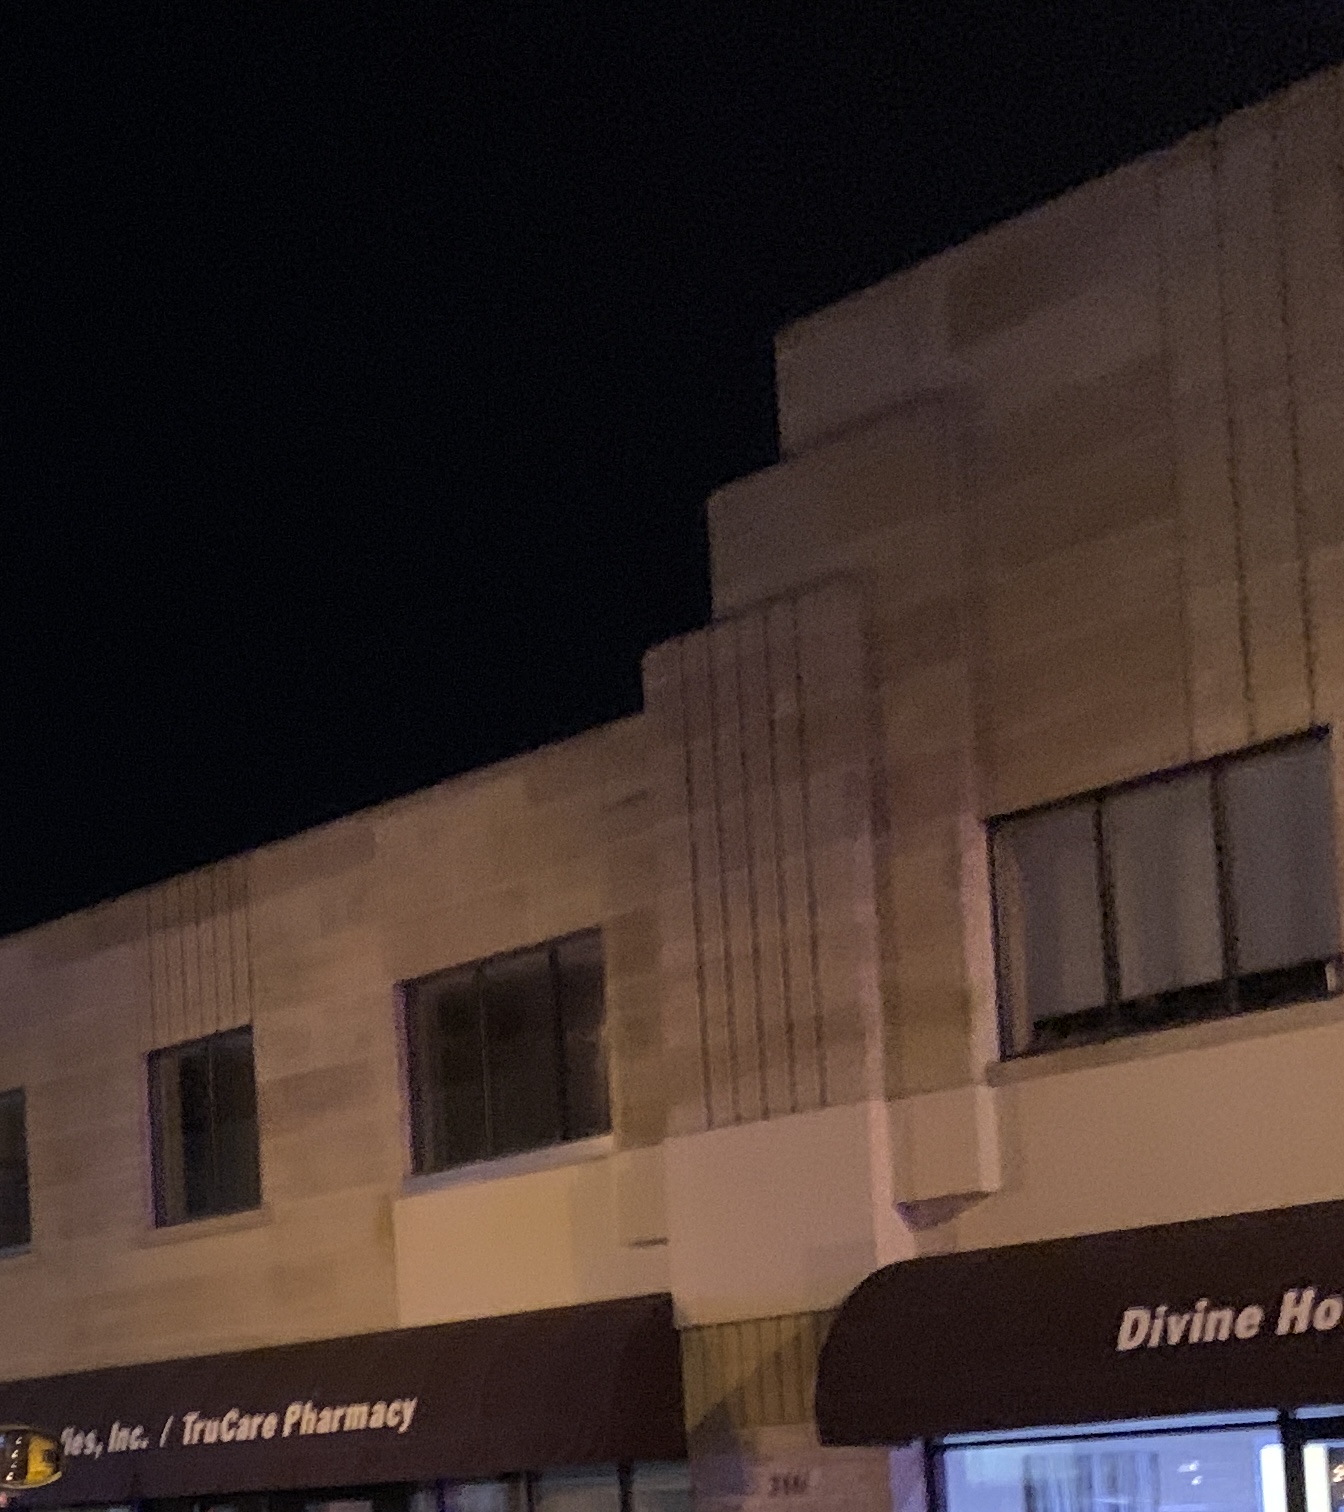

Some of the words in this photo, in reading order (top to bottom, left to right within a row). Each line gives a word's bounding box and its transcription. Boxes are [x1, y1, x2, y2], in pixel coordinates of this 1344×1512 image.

[1115, 1298, 1264, 1352] Divine
[108, 1420, 150, 1453] Inc.
[183, 1407, 279, 1446] TruCare
[282, 1397, 418, 1438] Pharmacy
